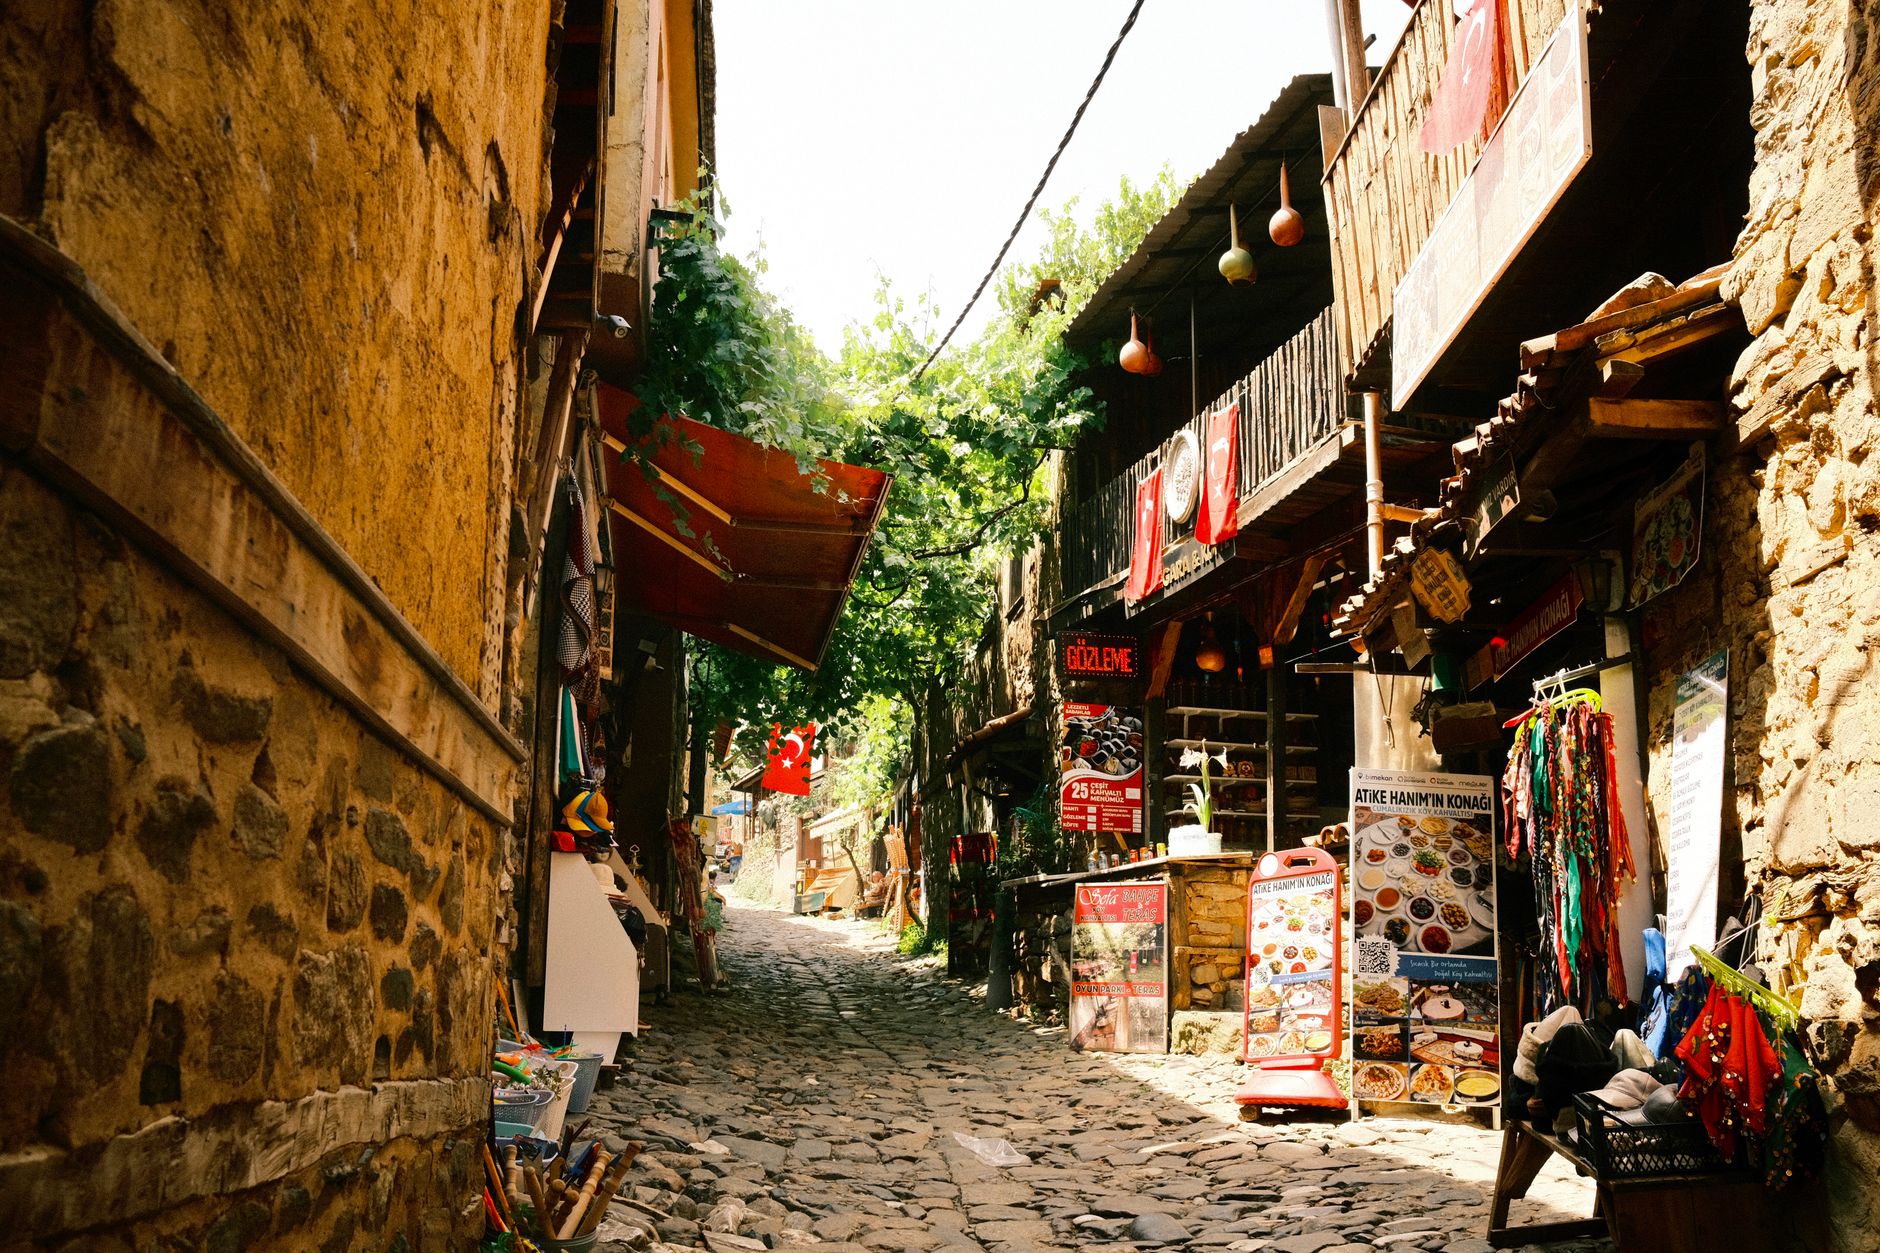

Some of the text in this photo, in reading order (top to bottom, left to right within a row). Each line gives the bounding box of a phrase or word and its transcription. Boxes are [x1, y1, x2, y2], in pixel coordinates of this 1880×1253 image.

[1192, 550, 1201, 569] &
[1539, 588, 1571, 635] KONAĞI
[1066, 638, 1133, 672] GÖZLEME
[1071, 782, 1108, 799] 25 ÇEŞİT
[1090, 789, 1122, 797] KAHVALTI
[1090, 795, 1125, 803] MENÜMÜZ
[1447, 793, 1492, 811] KONAĞI
[1372, 805, 1474, 818] CUMALIKIZIK KÖY KAHVALTISI
[1306, 873, 1333, 888] KONAĞI
[1079, 888, 1159, 906] Sefa BAHÇE
[1122, 908, 1158, 922] TERAS
[1076, 984, 1098, 993] OYUN
[1100, 985, 1125, 994] PARKI
[1133, 985, 1160, 994] TERAS
